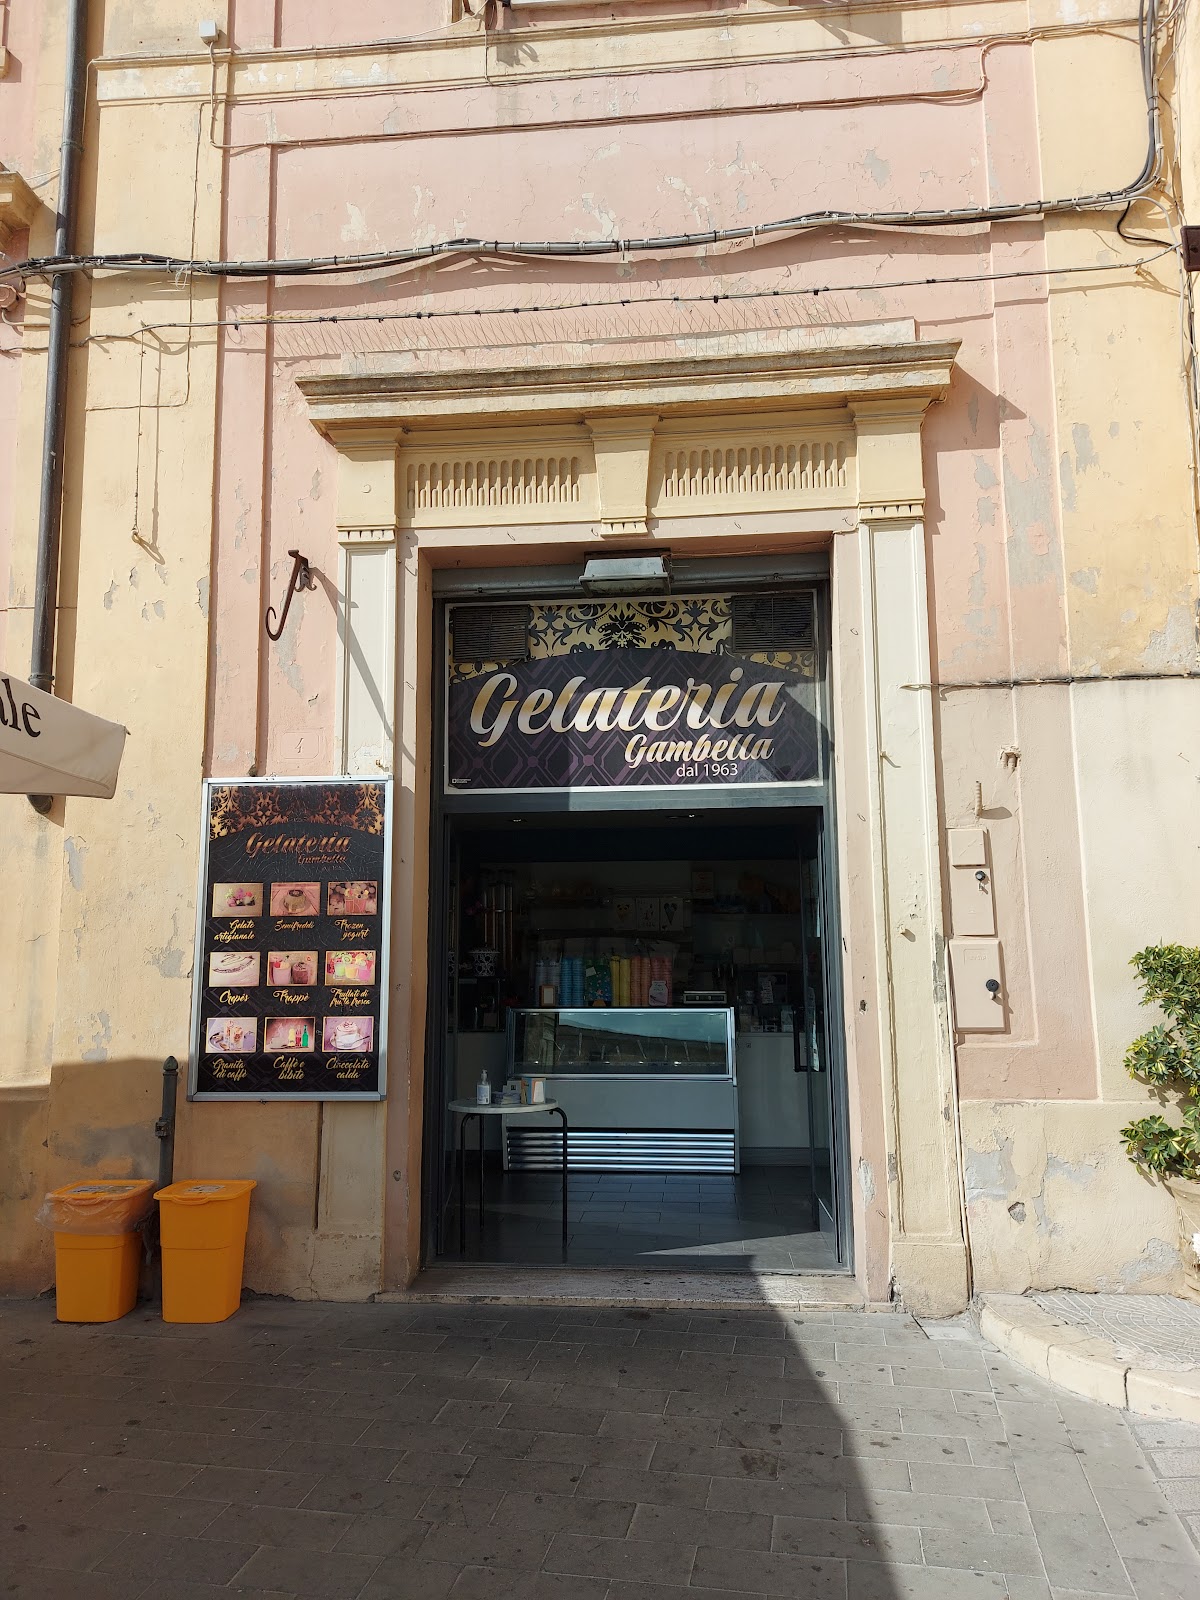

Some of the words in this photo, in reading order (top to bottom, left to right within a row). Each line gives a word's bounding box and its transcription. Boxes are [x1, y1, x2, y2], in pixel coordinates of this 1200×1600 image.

[469, 667, 787, 747] Gelateria
[624, 732, 775, 768] Gambella
[676, 763, 698, 777] dal
[703, 762, 739, 777] 1963
[245, 831, 352, 859] Gelateria
[274, 919, 315, 932] Semifreddi
[213, 930, 256, 944] artigianale
[341, 927, 370, 941] yogurt
[359, 988, 370, 998] di
[212, 1057, 246, 1076] Granita
[273, 1055, 299, 1072] Caffè
[215, 1067, 226, 1079] di
[226, 1068, 248, 1082] caffè
[336, 1069, 362, 1080] calda
